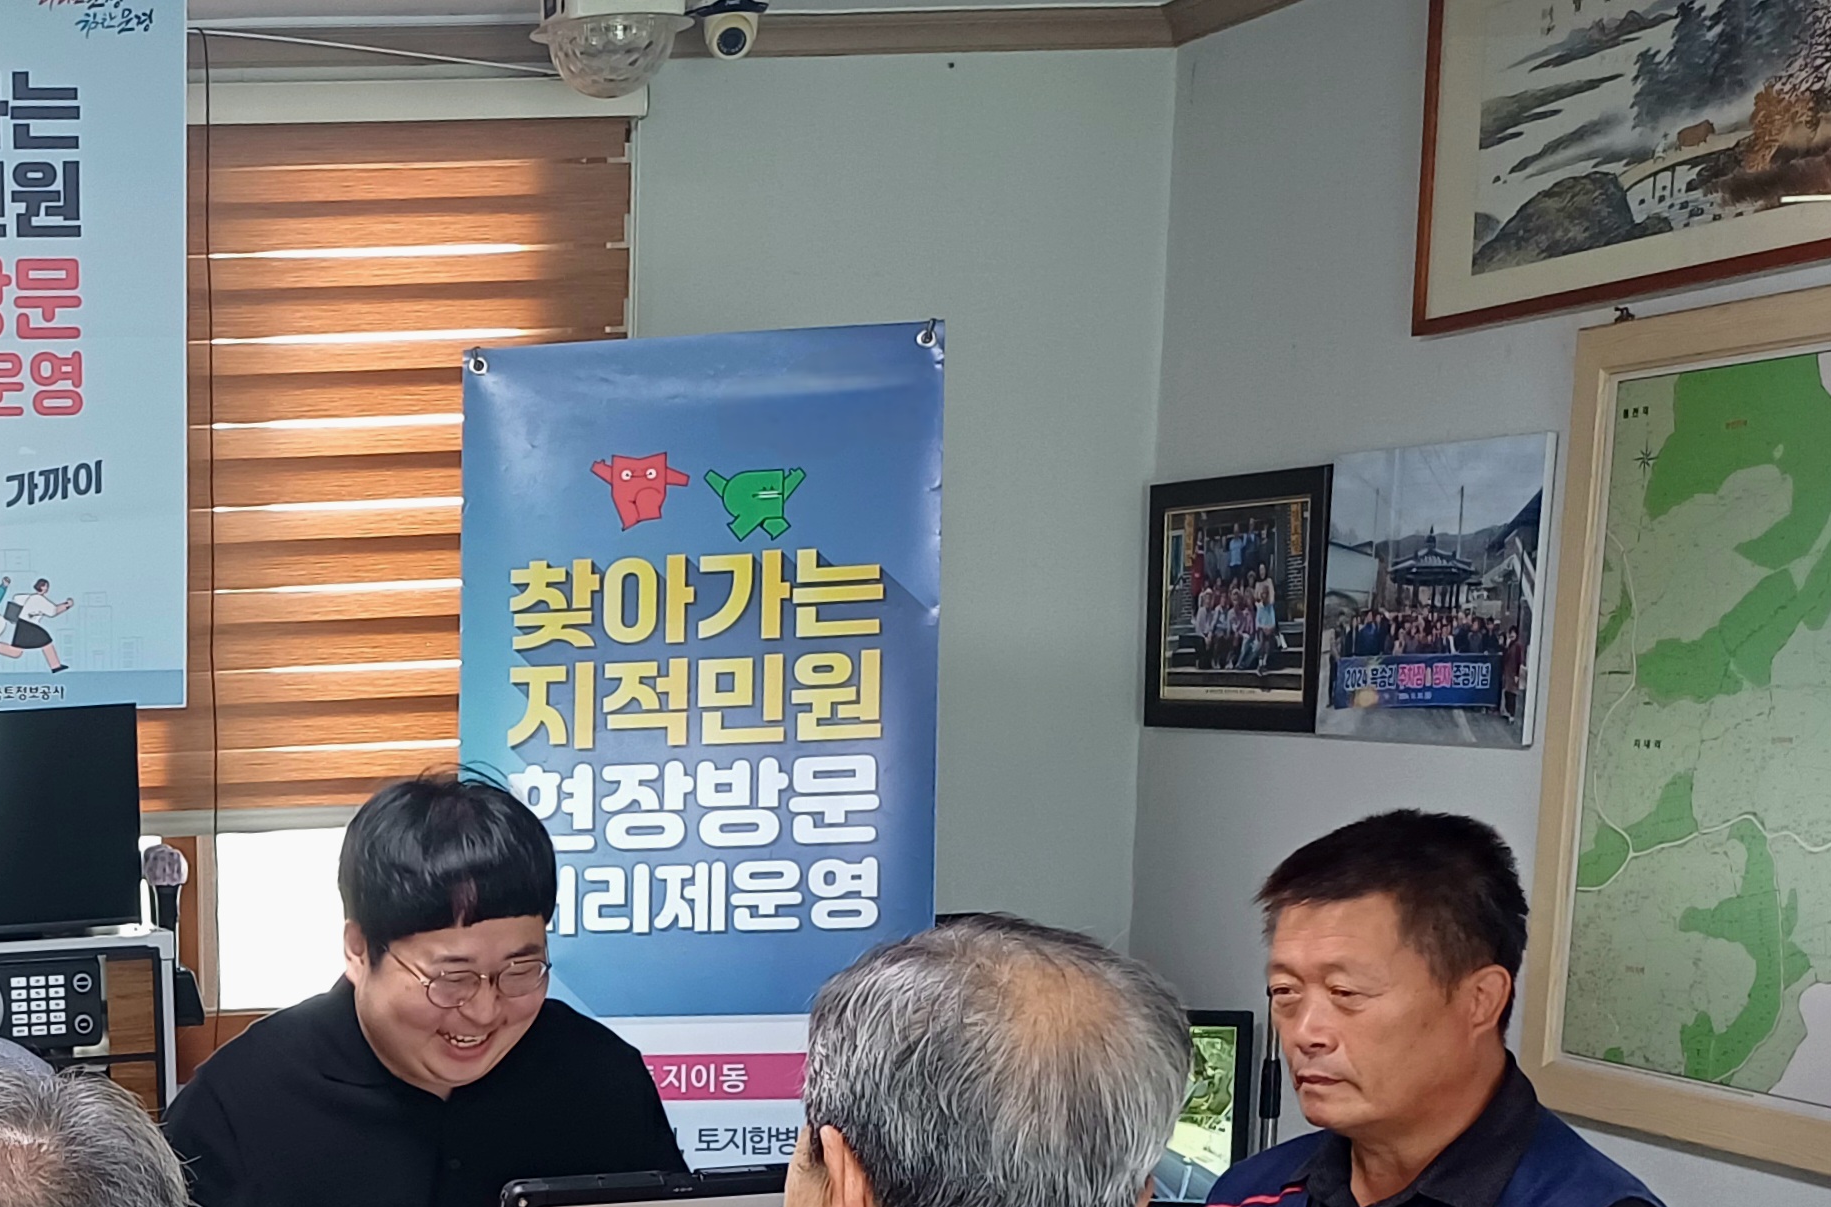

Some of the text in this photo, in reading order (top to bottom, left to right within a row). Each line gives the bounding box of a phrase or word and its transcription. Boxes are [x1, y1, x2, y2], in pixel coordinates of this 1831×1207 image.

[5, 460, 103, 508] 가까이
[509, 548, 885, 651] 찾아가는
[507, 648, 883, 750] 지적민원
[508, 754, 882, 853] 현장방문
